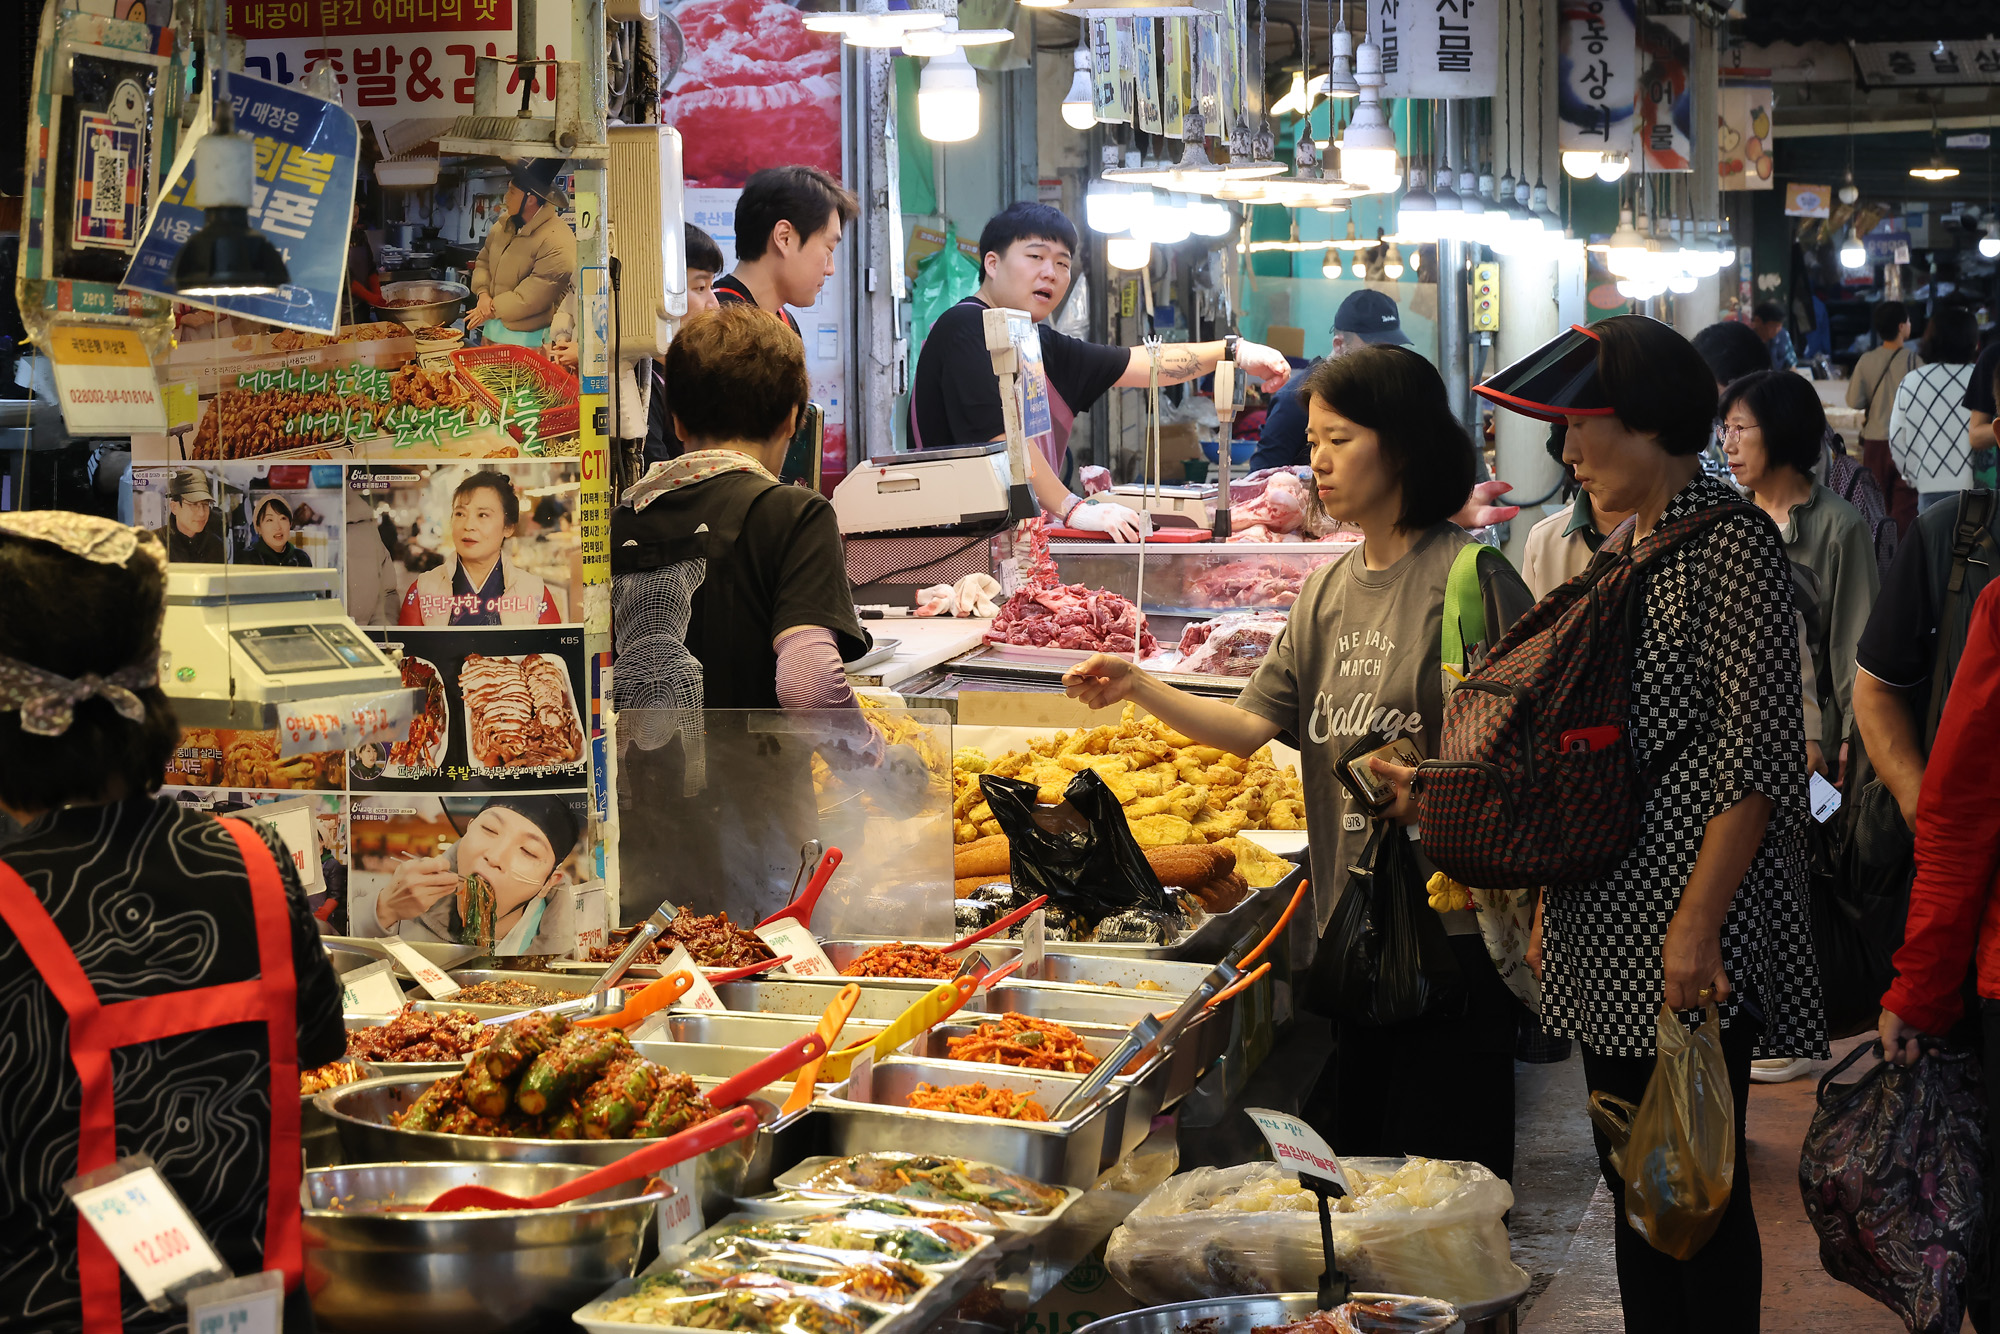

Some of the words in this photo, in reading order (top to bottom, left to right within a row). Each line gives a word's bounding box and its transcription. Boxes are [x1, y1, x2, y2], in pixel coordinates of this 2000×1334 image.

[245, 2, 309, 29] 내공이
[322, 0, 362, 26] 담긴
[372, 0, 463, 23] 어머니의
[475, 0, 497, 21] 맛
[252, 102, 299, 133] 매장은
[82, 291, 106, 306] zero
[238, 368, 328, 395] 어머니의
[334, 363, 392, 402] 노력을
[69, 388, 155, 405] 028002-04-018104
[285, 409, 378, 440] 이어가고
[385, 405, 471, 449] 싶었던
[479, 388, 543, 453] 아들
[420, 593, 481, 618] 꽃단장한
[487, 596, 532, 612] 어머니
[560, 636, 580, 645] KBS
[1364, 629, 1396, 657] LAST
[1339, 658, 1382, 677] MATCH
[177, 747, 199, 759] 풍미를
[200, 748, 223, 759] 살리는
[180, 759, 202, 774] 자두
[397, 766, 444, 781] 파김치가
[446, 765, 481, 781] 족발과
[484, 766, 508, 780] 정말
[569, 801, 588, 809] KBS
[1344, 815, 1362, 828] 1978
[793, 954, 827, 977] 무말랭이
[1275, 1142, 1337, 1175] 절임마늘쫑
[133, 1227, 191, 1268] 12,000
